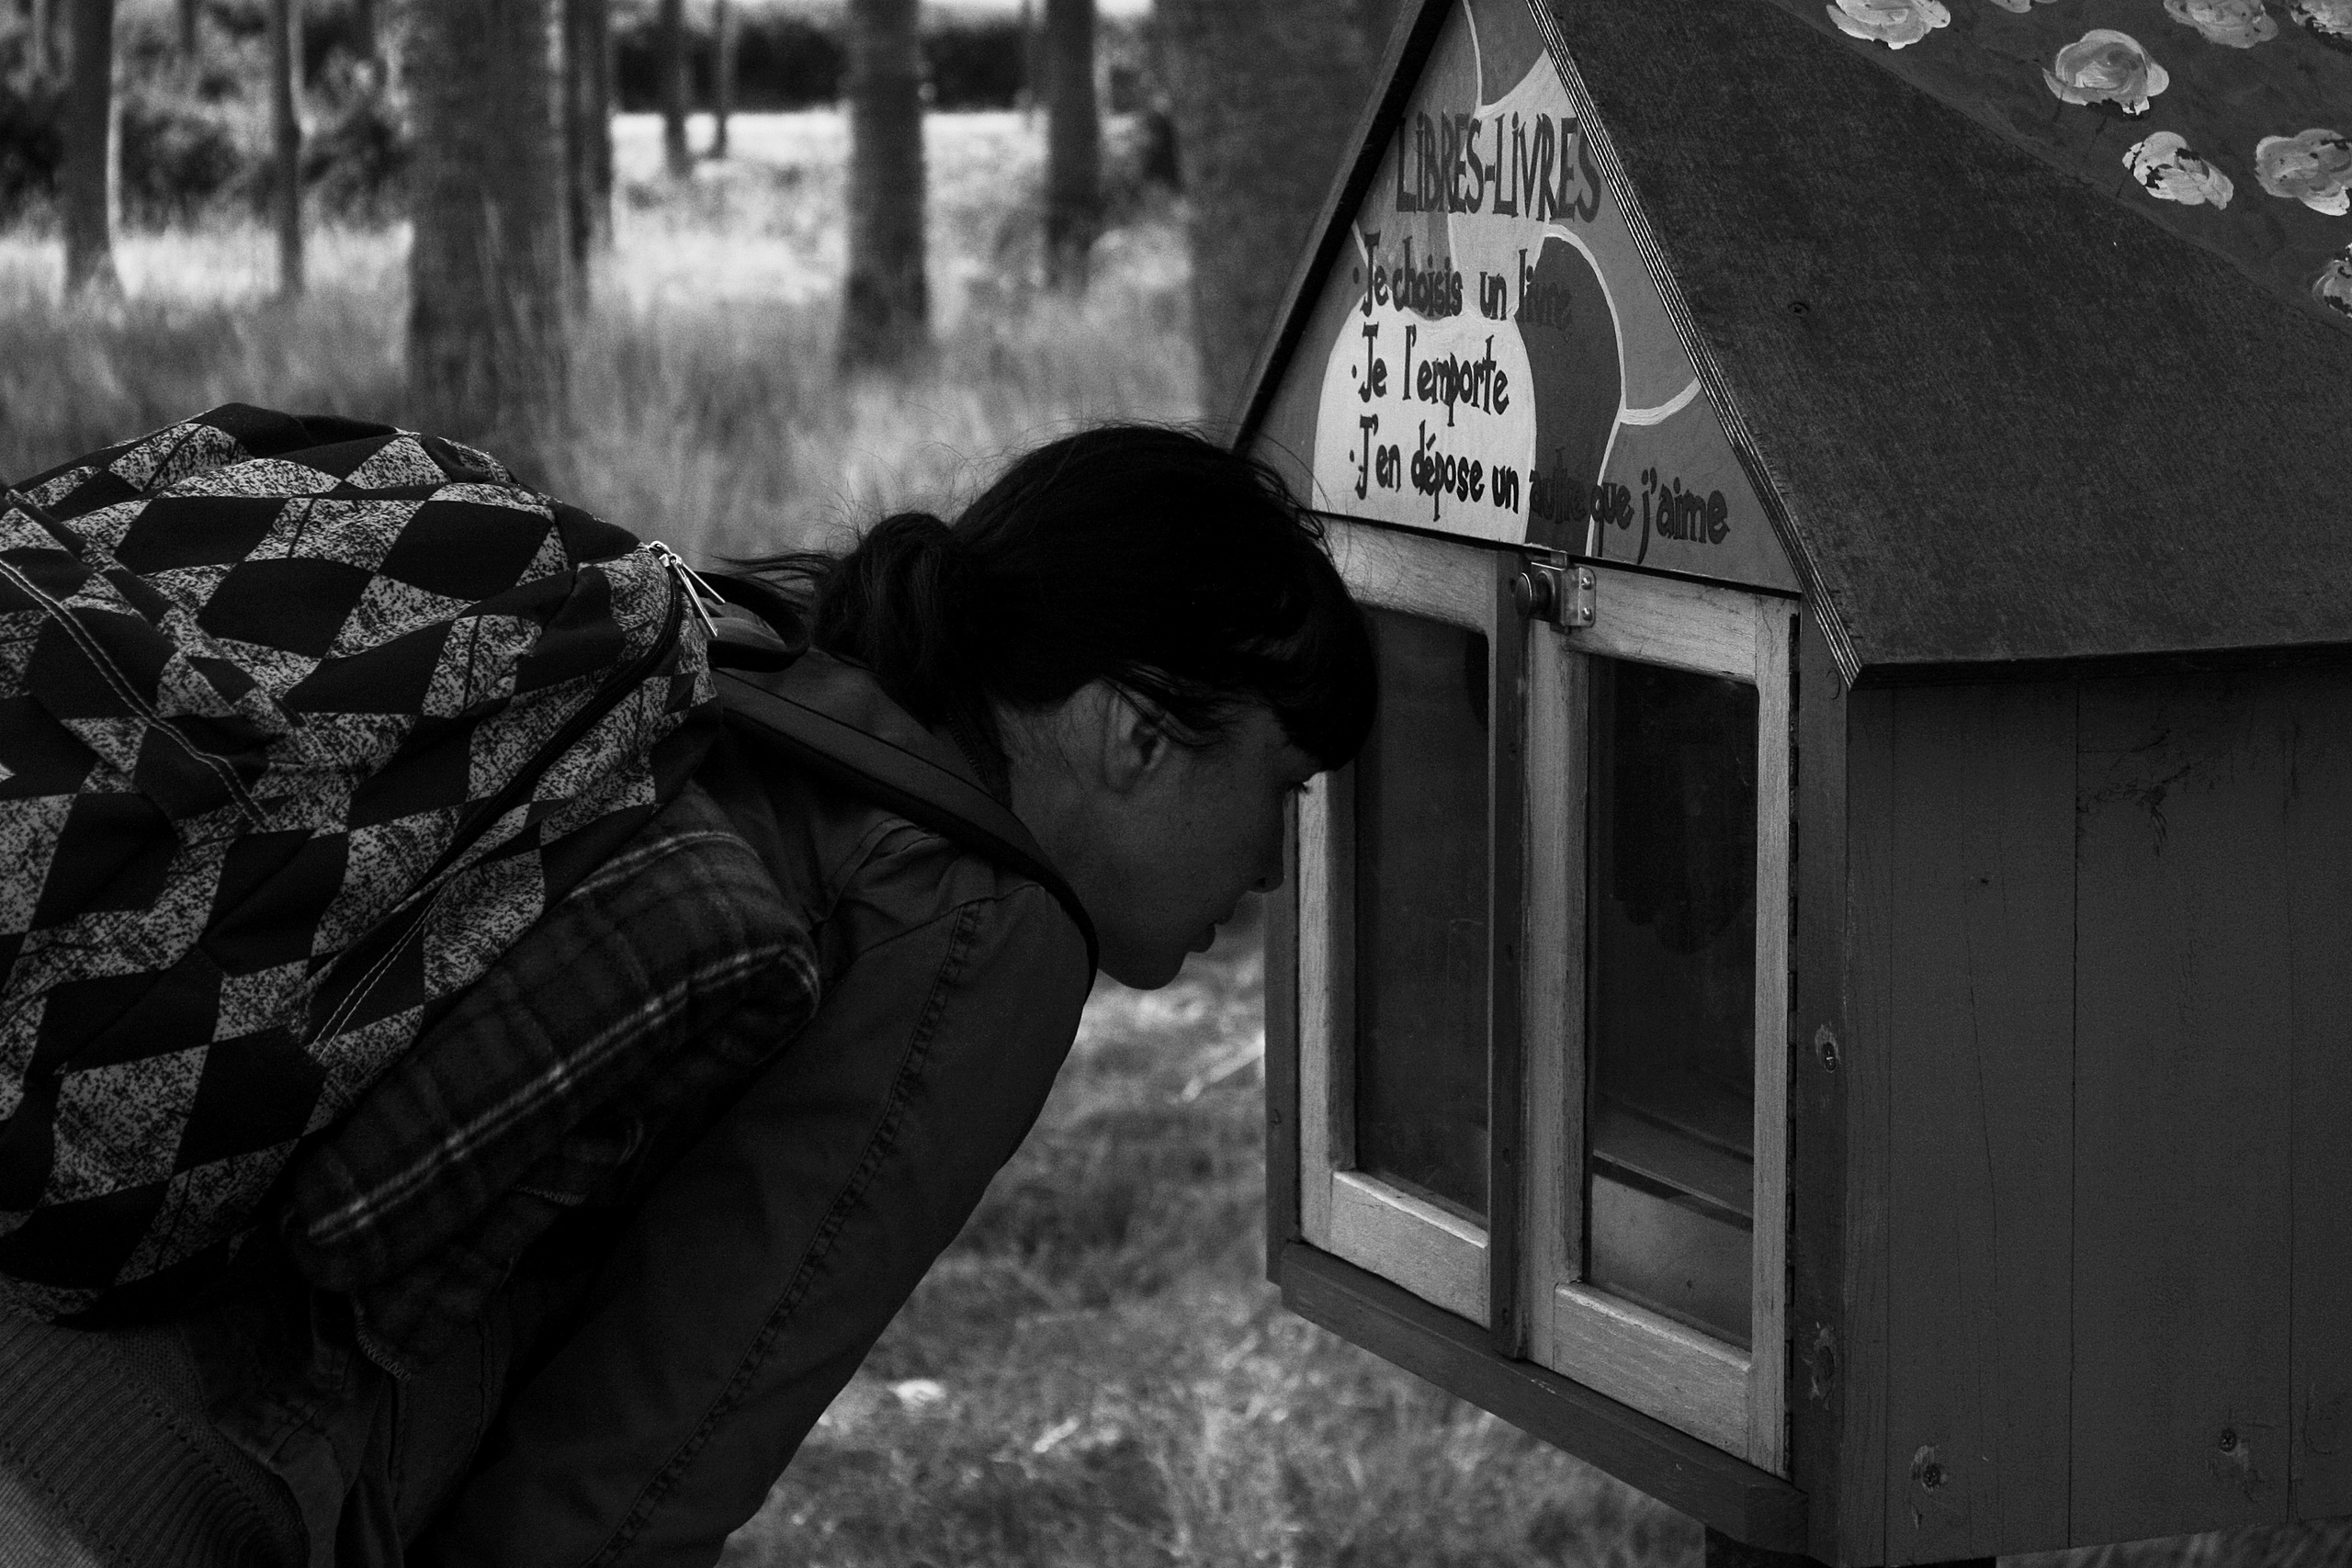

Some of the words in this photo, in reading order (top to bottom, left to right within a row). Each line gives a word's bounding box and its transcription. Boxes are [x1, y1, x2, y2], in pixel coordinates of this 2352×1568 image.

[1360, 230, 1388, 317] Je
[1392, 235, 1463, 317] choisis
[1479, 271, 1507, 321] un
[1516, 248, 1573, 331] livre
[1358, 321, 1387, 402] Je
[1402, 323, 1510, 427] l'emporte
[1355, 413, 1402, 501] J'en
[1410, 419, 1485, 522] dépose
[1492, 465, 1519, 514] un
[1590, 481, 1635, 558] que
[1636, 466, 1731, 565] j'aime
